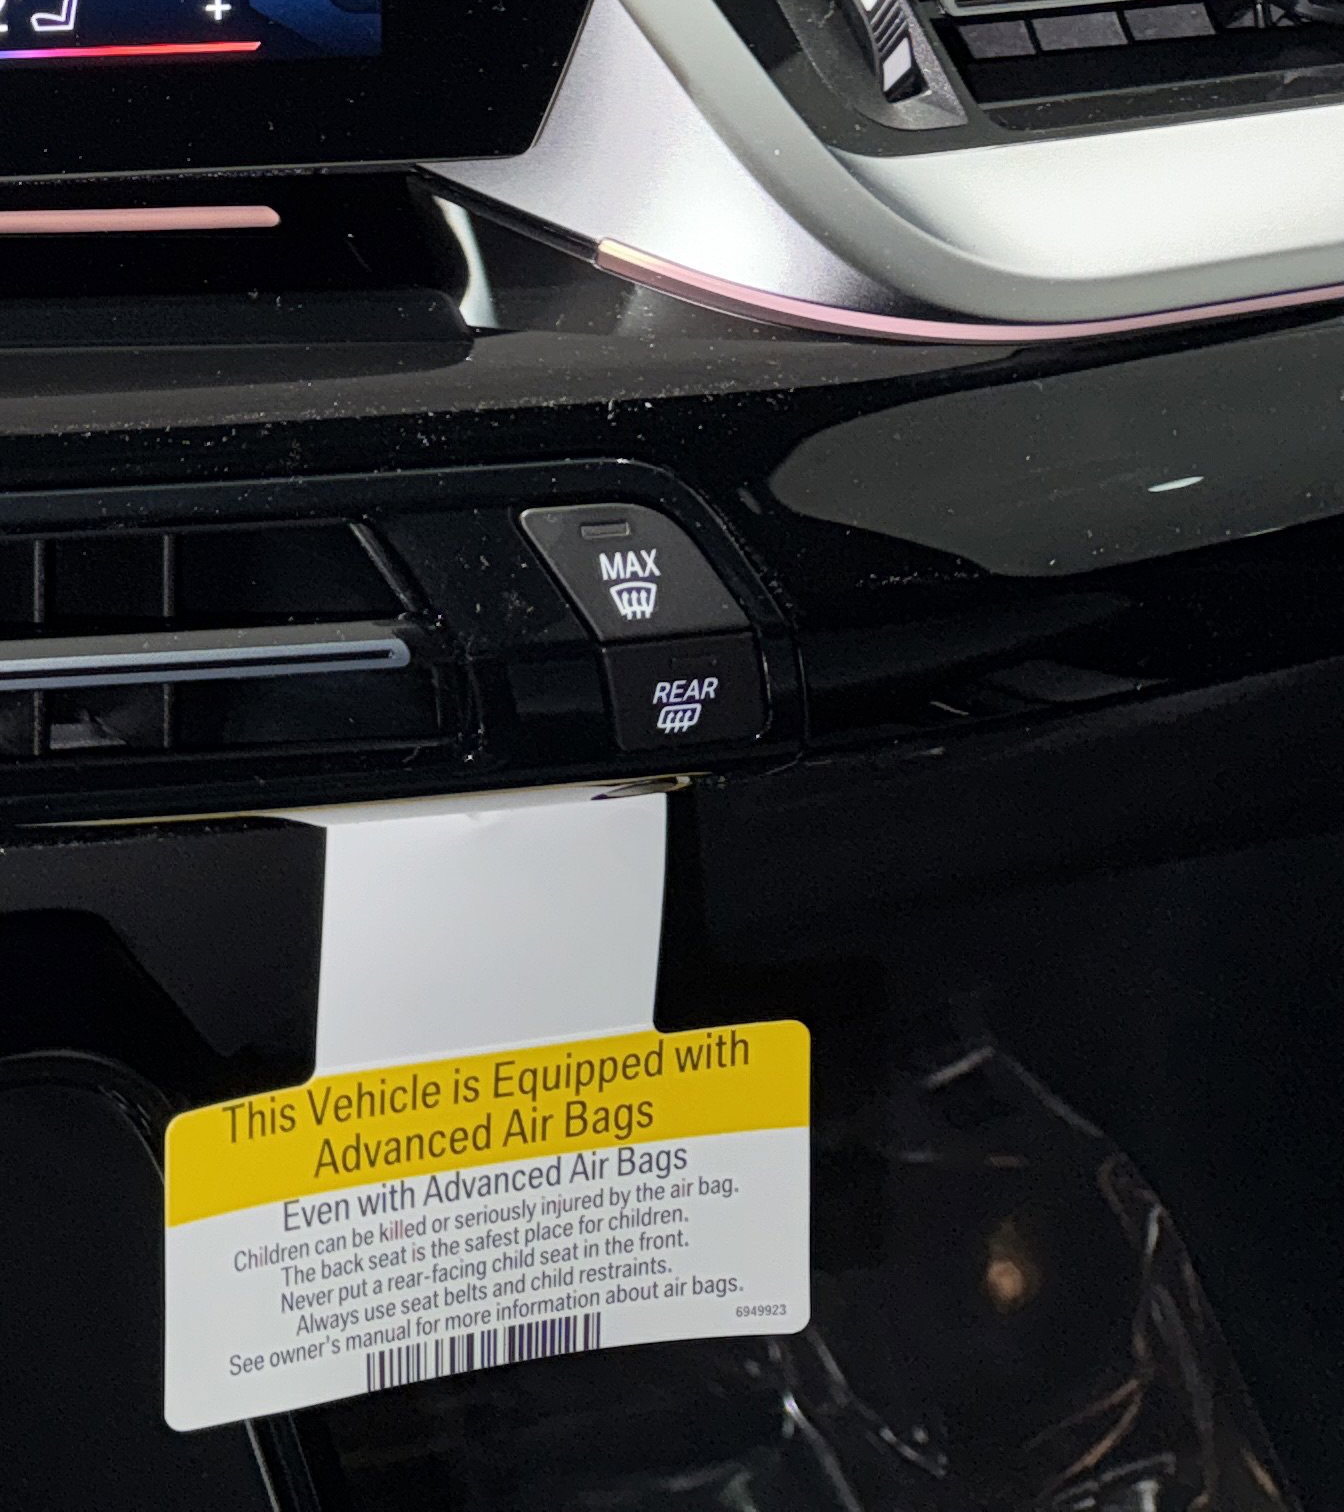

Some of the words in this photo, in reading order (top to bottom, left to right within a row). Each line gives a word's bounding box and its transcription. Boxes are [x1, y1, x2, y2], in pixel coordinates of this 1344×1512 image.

[599, 548, 661, 581] MAX
[652, 676, 719, 706] REAR
[222, 1098, 296, 1145] This
[307, 1073, 441, 1128] Vehicle
[453, 1067, 480, 1105] is
[493, 1039, 664, 1102] Equipped
[675, 1029, 751, 1074] with
[314, 1112, 492, 1179] Advanced
[504, 1107, 554, 1148] Air
[565, 1097, 655, 1141] Bags
[233, 1241, 310, 1273] Children
[315, 1235, 347, 1256] can
[352, 1227, 374, 1249] be
[379, 1215, 427, 1243] killed
[431, 1215, 449, 1234] or
[454, 1198, 537, 1231] seriously
[541, 1188, 604, 1219] injured
[609, 1186, 631, 1209] by
[636, 1182, 666, 1204] the
[670, 1178, 694, 1199] air
[698, 1175, 740, 1198] bag.
[282, 1198, 350, 1233] Even
[357, 1179, 416, 1218] with
[423, 1155, 562, 1207] Advanced
[569, 1151, 610, 1184] Air
[617, 1145, 688, 1180] Bags
[280, 1288, 334, 1314] Never
[338, 1279, 368, 1307] put
[372, 1278, 384, 1296] a
[387, 1257, 487, 1293] rear-facing
[492, 1246, 535, 1273] child
[539, 1243, 579, 1267] seat
[583, 1239, 600, 1260] in
[604, 1234, 634, 1257] the
[639, 1228, 690, 1252] front.
[281, 1265, 316, 1288] The
[321, 1255, 364, 1281] back
[368, 1245, 407, 1270] seat
[412, 1242, 426, 1263] is
[430, 1237, 460, 1260] the
[464, 1227, 520, 1253] safest
[524, 1219, 574, 1247] place
[578, 1216, 604, 1235] for
[608, 1205, 690, 1232] children.
[229, 1353, 265, 1377] See
[269, 1335, 341, 1368] owner's
[345, 1318, 412, 1353] manual
[415, 1318, 442, 1338] for
[445, 1308, 492, 1333] more
[496, 1289, 601, 1322] information
[605, 1281, 659, 1305] about
[664, 1275, 688, 1298] air
[692, 1274, 744, 1299] bags.
[296, 1308, 360, 1337] Always
[364, 1302, 396, 1323] use
[400, 1291, 440, 1317] seat
[444, 1281, 488, 1308] belts
[492, 1274, 526, 1297] and
[530, 1266, 574, 1292] child
[578, 1255, 673, 1285] restraints.
[735, 1303, 788, 1318] 6949923
